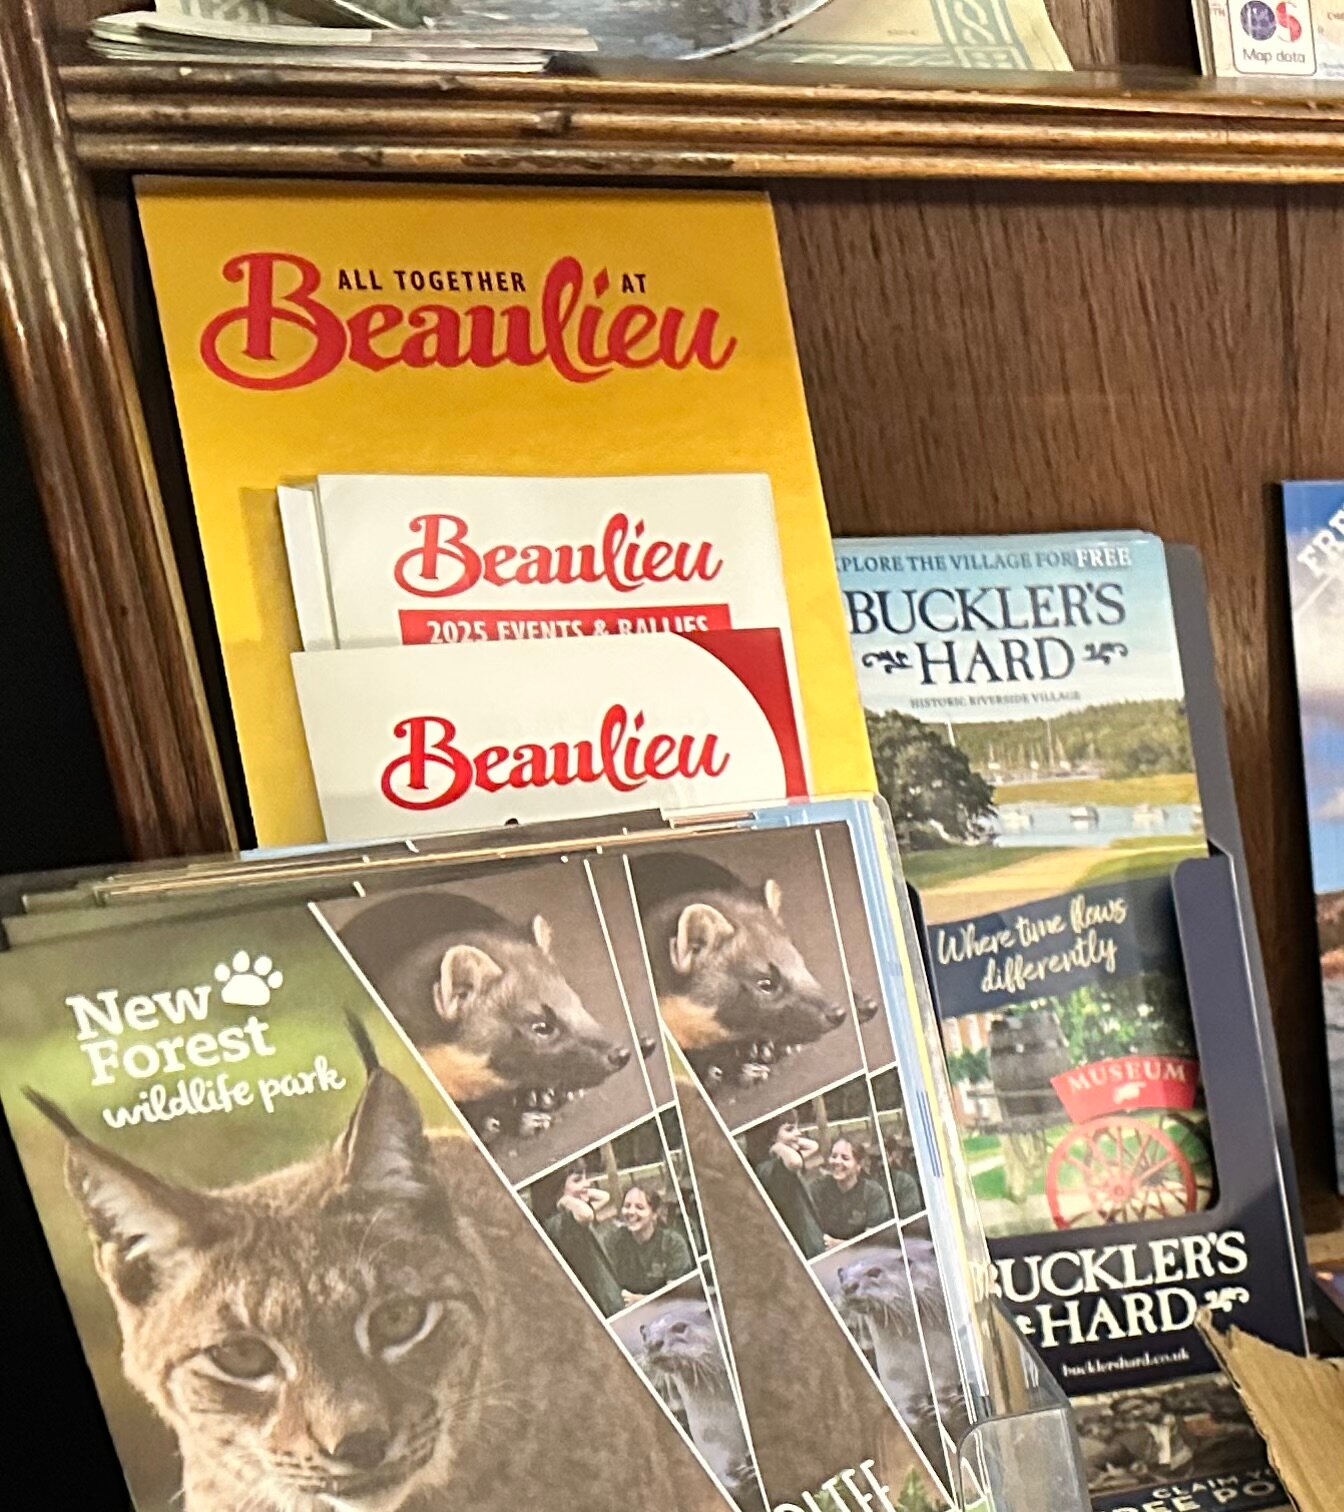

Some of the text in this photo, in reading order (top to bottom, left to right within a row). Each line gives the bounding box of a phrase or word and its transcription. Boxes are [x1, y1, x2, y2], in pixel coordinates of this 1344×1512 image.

[1243, 49, 1306, 64] Map data
[337, 268, 647, 294] ALL TOGETHER AT
[200, 251, 738, 391] Beaulieu
[394, 512, 724, 599] Beaulieu
[910, 554, 947, 572] THE
[950, 553, 1033, 570] VILLAGE
[1035, 551, 1075, 568] FOR
[1076, 546, 1133, 568] FREE
[427, 620, 486, 643] 2025
[496, 618, 581, 640] EVENTS
[844, 582, 1128, 635] BUCKLER'S
[915, 636, 1075, 685] HARD
[910, 690, 1081, 709] HISTORIC RIVERSIDE VILLAGE
[380, 703, 730, 811] Beaulieu
[937, 894, 1128, 965] Where time flows
[980, 933, 1117, 993] differently
[65, 984, 213, 1041] New
[80, 1015, 277, 1087] Forest
[1067, 1059, 1188, 1094] MUSEUM
[102, 1055, 347, 1129] wildlife park
[1035, 1286, 1199, 1349] HARD
[1062, 1347, 1191, 1379] bucklershard.co.uk
[1152, 1475, 1239, 1500] CLAIM
